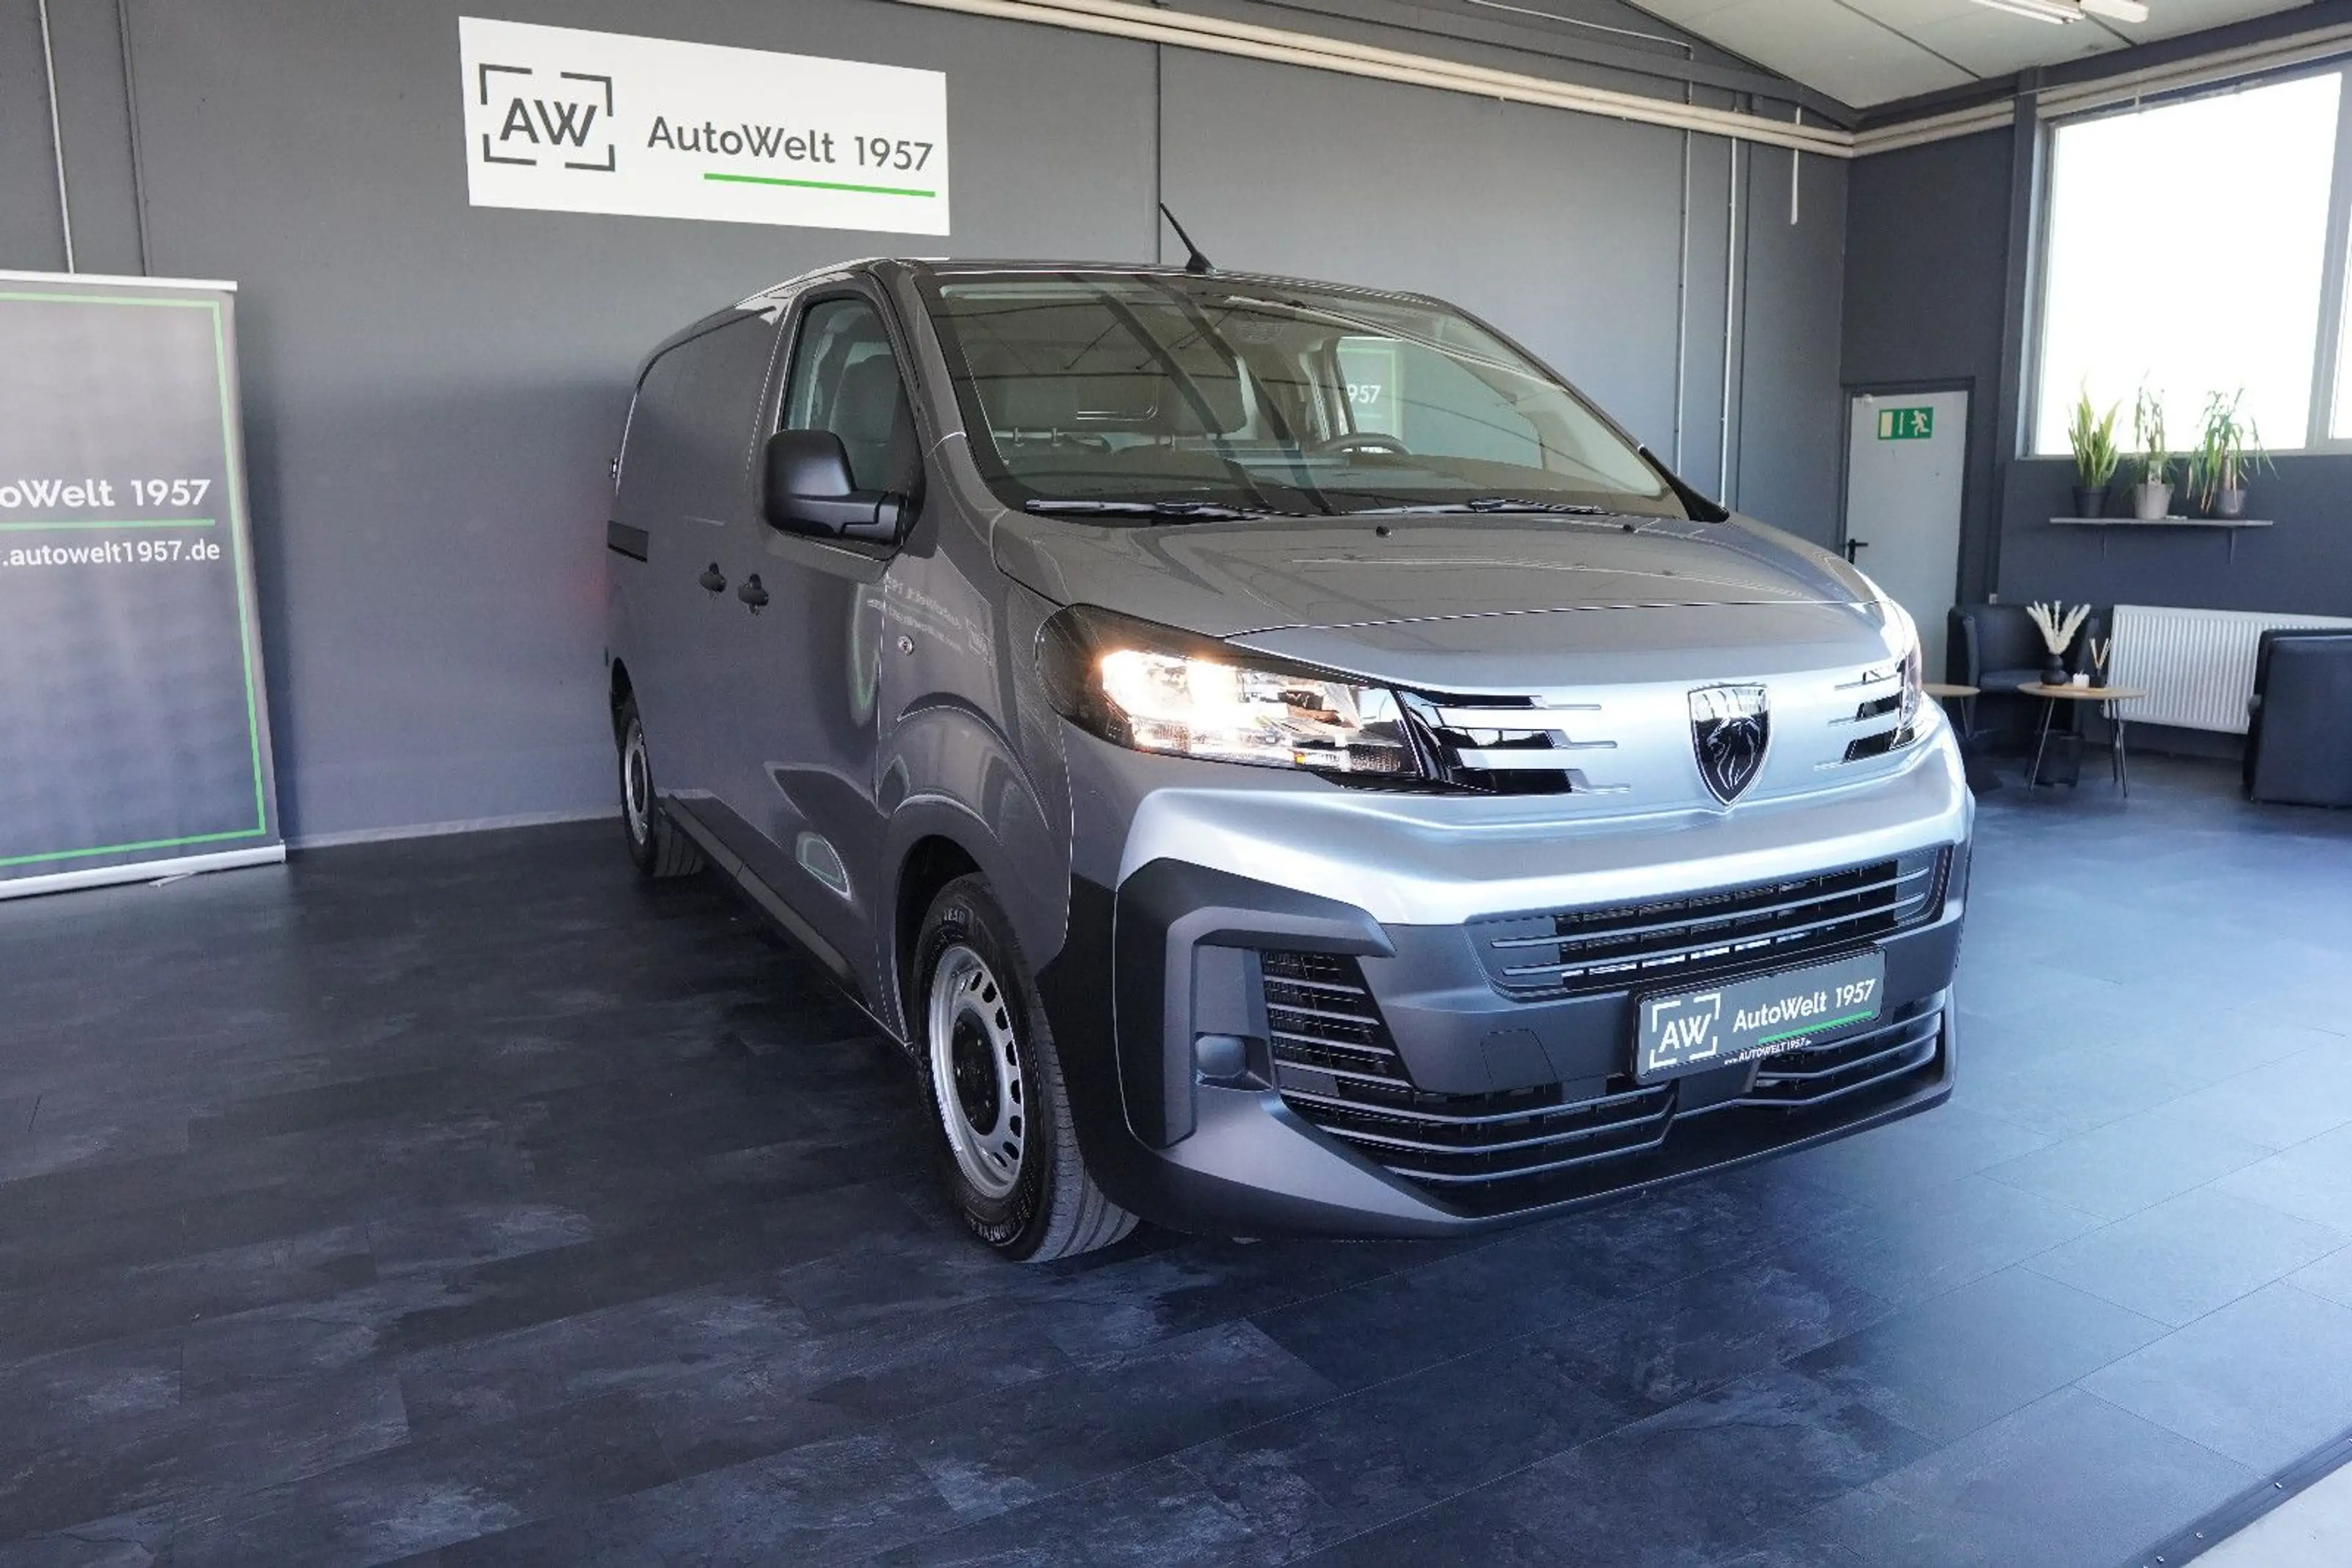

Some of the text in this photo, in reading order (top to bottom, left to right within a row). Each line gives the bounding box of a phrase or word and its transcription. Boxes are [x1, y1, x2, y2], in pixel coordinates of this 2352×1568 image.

[499, 97, 598, 148] AW
[647, 115, 933, 172] AutoWelt 1957
[0, 478, 211, 508] oWelt 1957
[1732, 978, 1876, 1033] AutoWelt 1957
[1658, 1012, 1713, 1054] AW
